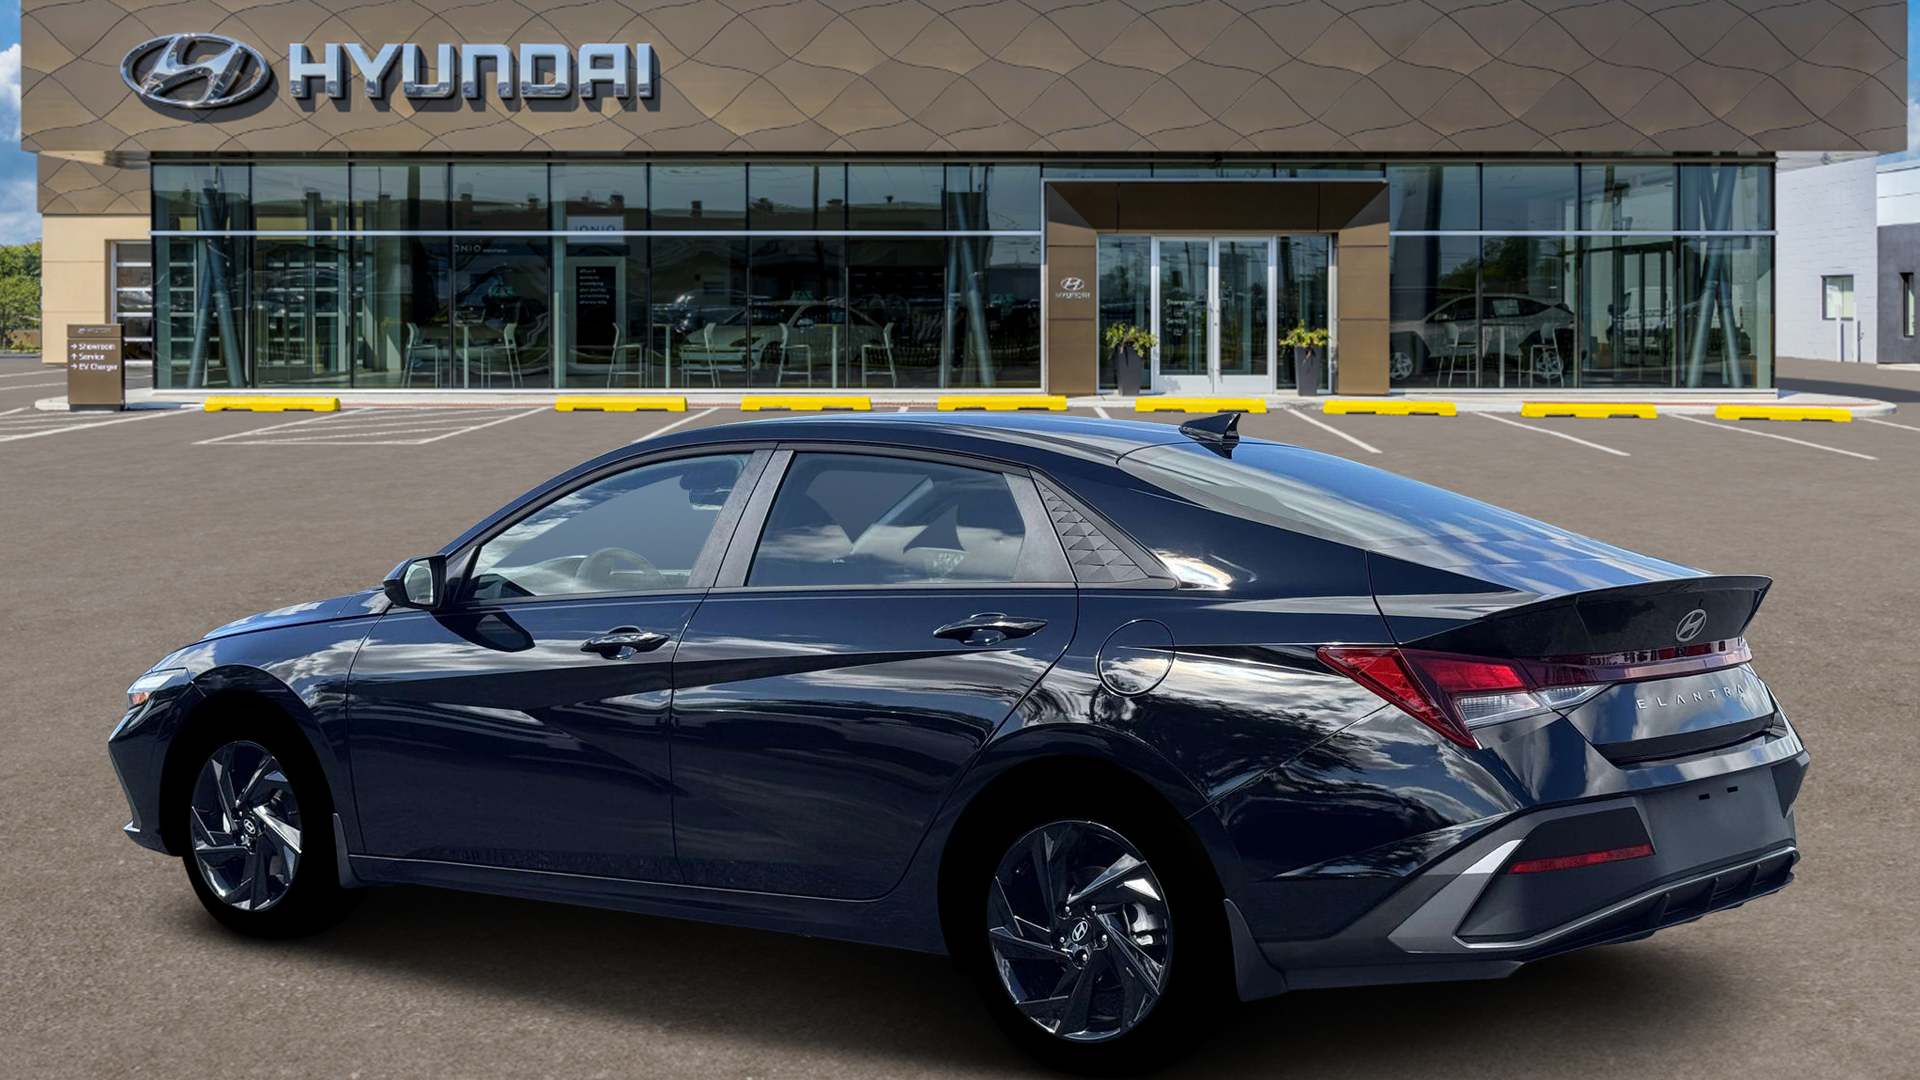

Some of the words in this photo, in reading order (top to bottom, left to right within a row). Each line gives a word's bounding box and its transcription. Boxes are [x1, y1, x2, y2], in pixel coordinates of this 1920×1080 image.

[289, 43, 653, 99] HYUNDAI
[78, 342, 116, 351] Showroom
[78, 352, 105, 360] Service
[78, 363, 89, 371] EV
[90, 363, 118, 372] Charger
[1636, 684, 1745, 710] ELANTRA
